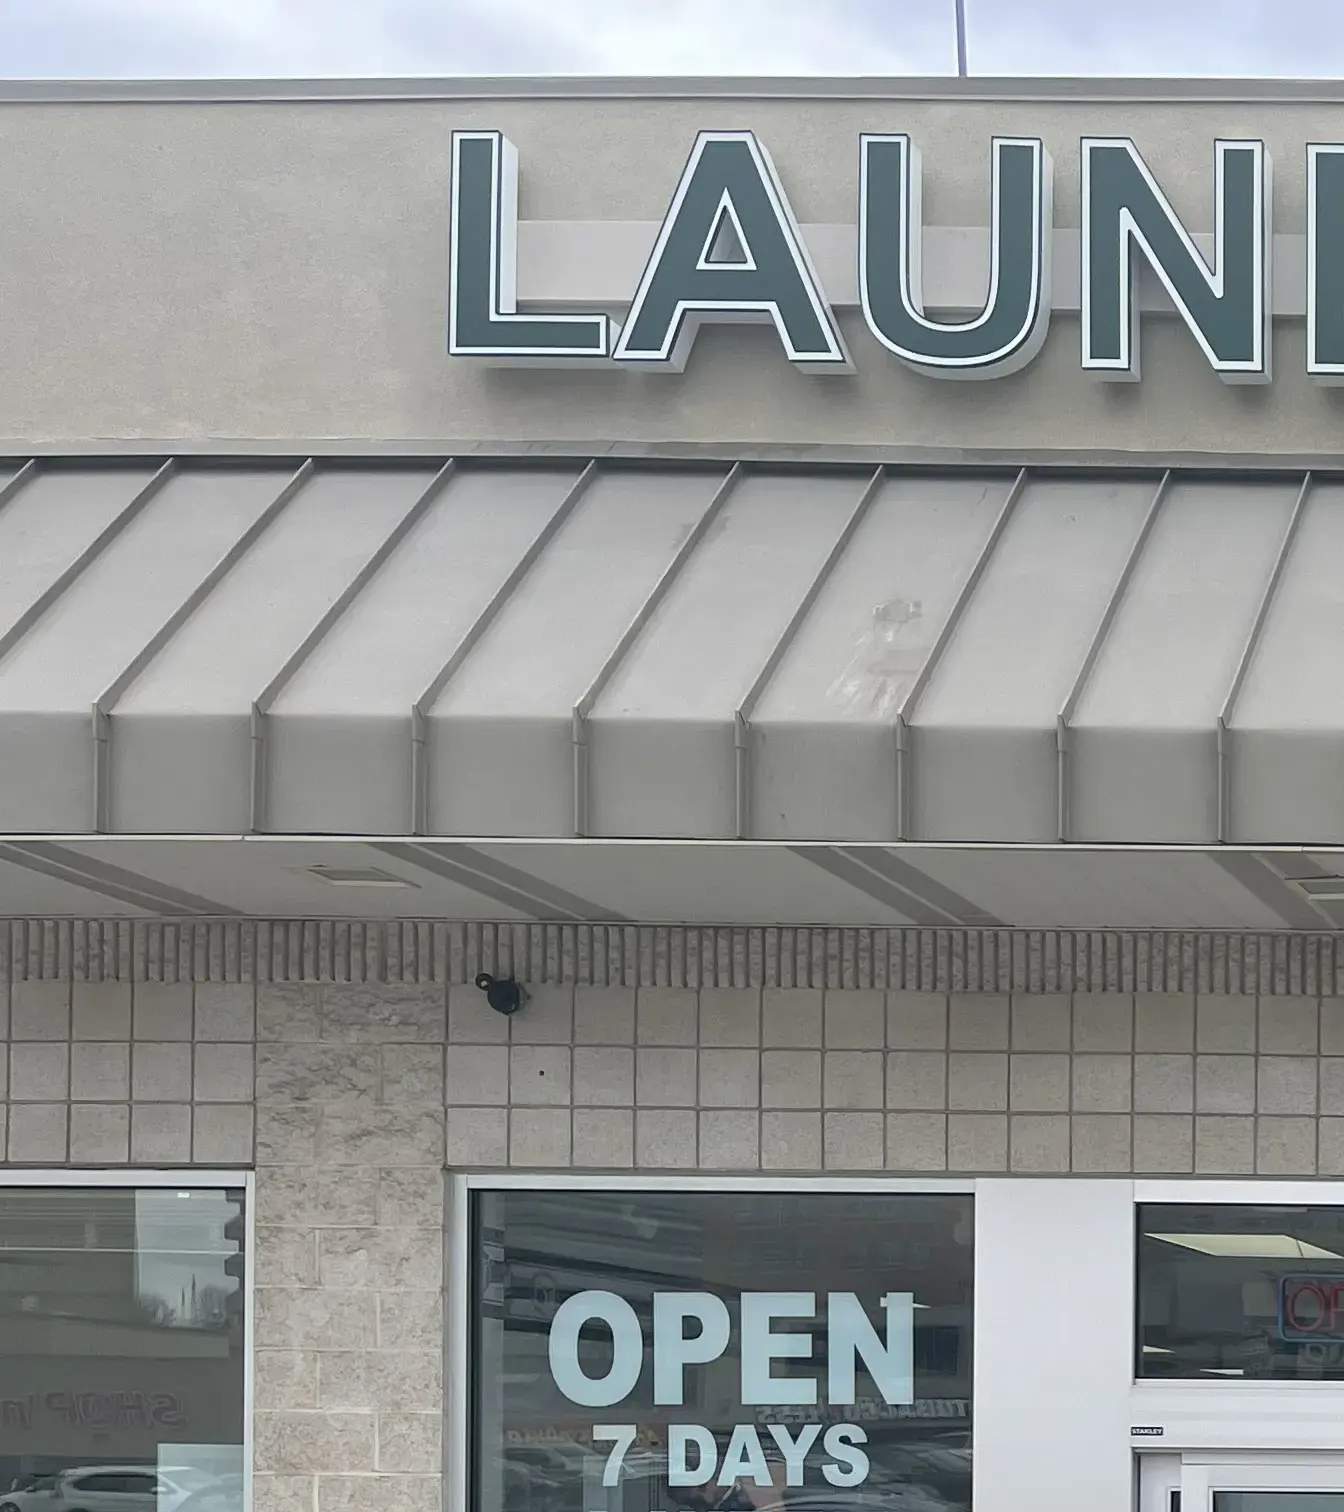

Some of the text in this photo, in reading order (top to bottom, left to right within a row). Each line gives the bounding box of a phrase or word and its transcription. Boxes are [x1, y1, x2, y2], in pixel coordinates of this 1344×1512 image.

[548, 1289, 915, 1407] OPEN
[593, 1424, 870, 1488] 7 DAYS
